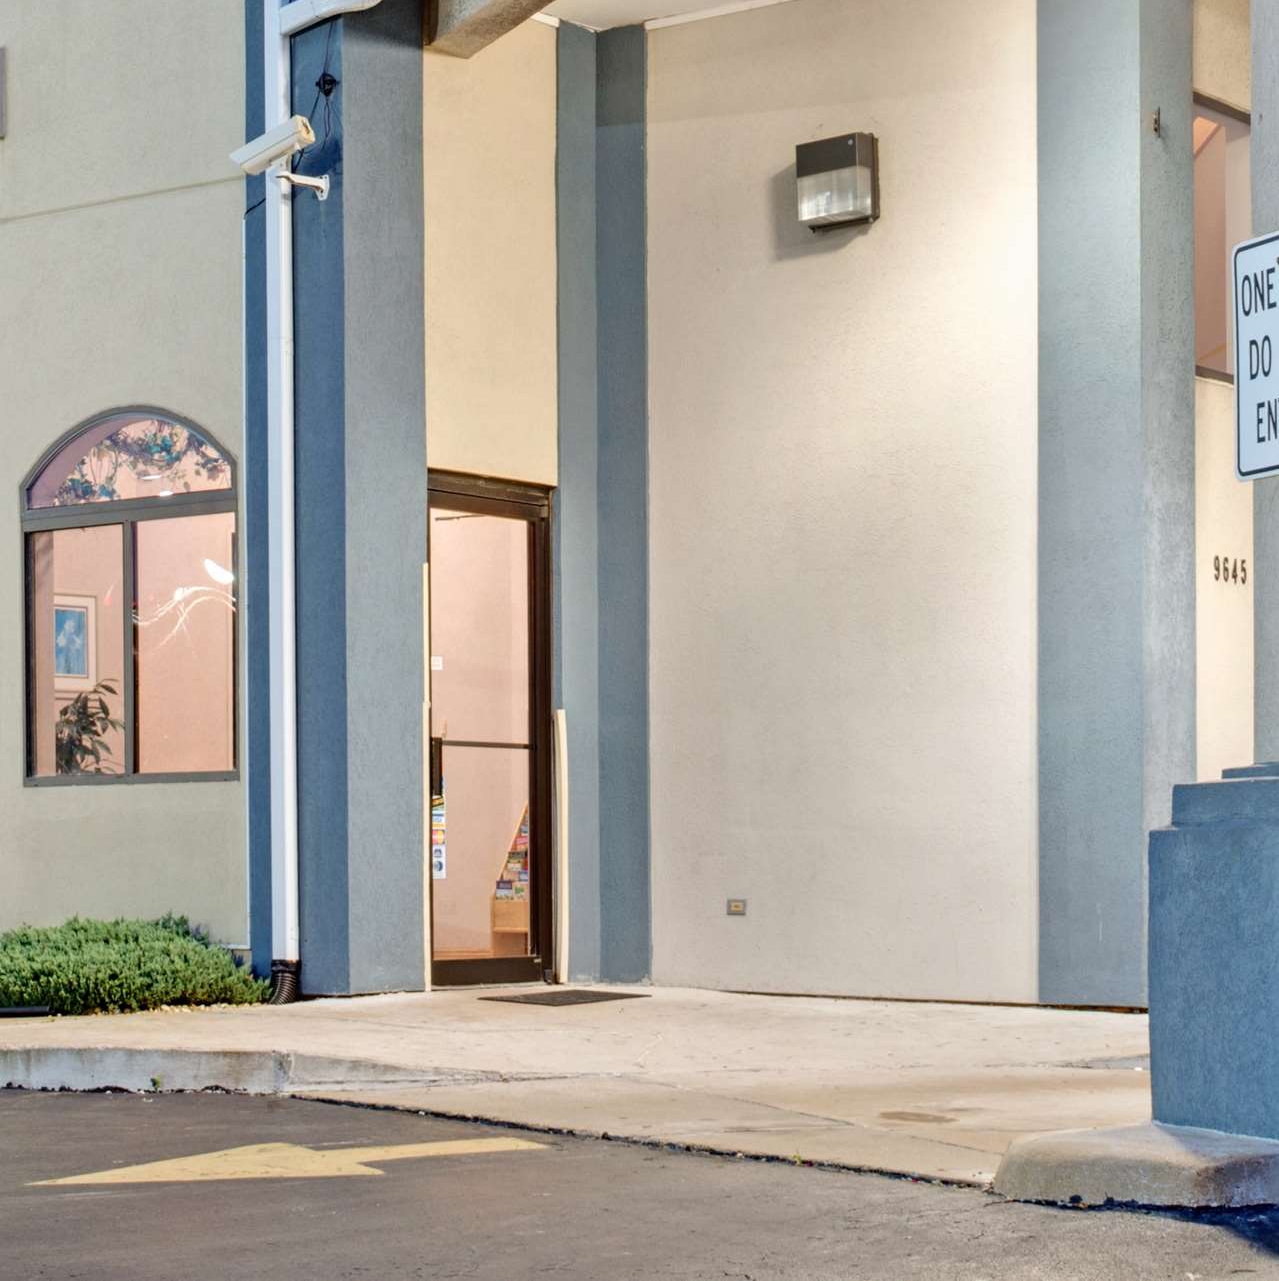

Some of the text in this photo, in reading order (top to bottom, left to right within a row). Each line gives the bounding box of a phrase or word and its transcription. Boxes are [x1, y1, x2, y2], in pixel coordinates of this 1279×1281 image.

[1241, 267, 1277, 317] ONE
[1249, 335, 1272, 380] DO
[1213, 555, 1247, 584] 9645
